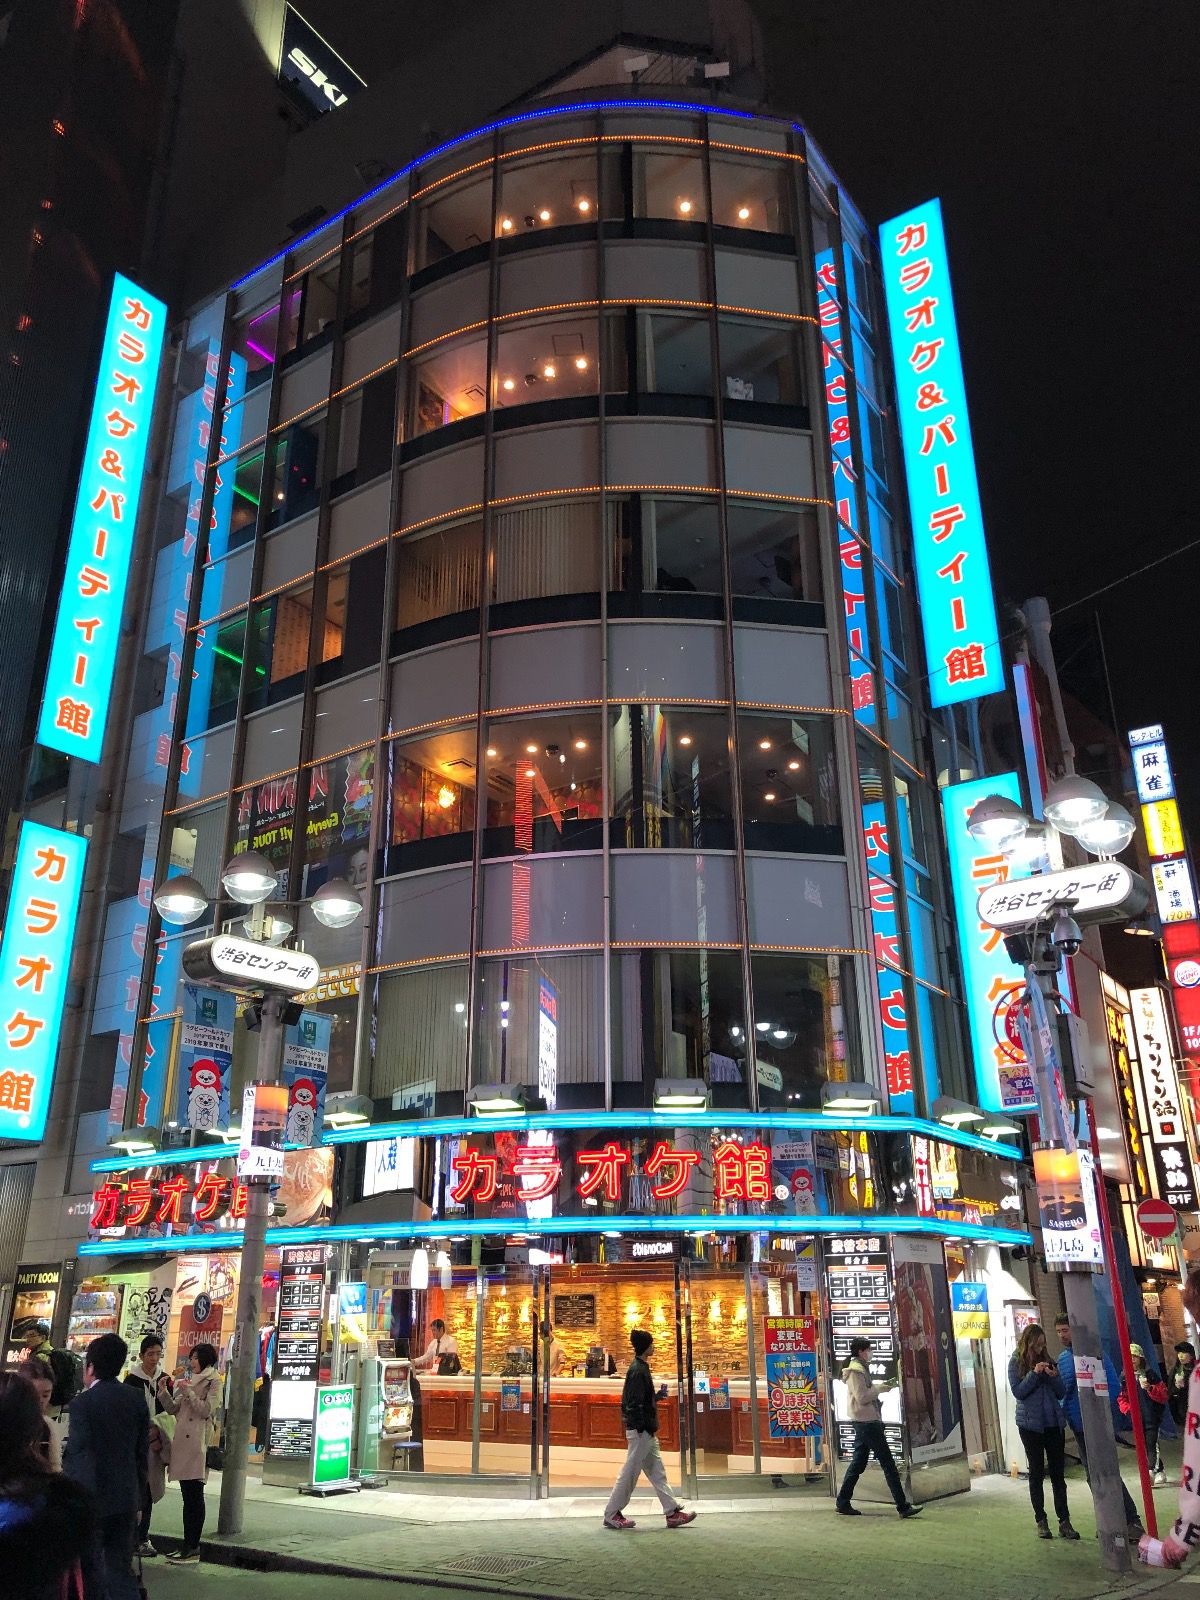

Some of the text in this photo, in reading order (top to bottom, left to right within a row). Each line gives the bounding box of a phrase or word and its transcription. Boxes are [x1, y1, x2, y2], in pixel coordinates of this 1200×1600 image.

[896, 223, 988, 686] カラオケ&パーティー館
[56, 298, 152, 738] カラオケ&パーティー館
[1142, 752, 1163, 791] 麻雀
[987, 872, 1120, 915] 渋谷センター街
[217, 946, 314, 981] 渋谷センター街
[0, 846, 68, 1113] カラオケ館
[450, 1142, 771, 1203] カラオケ館
[1167, 1194, 1192, 1205] B1F
[1048, 1216, 1084, 1229] SASEBO
[18, 1272, 59, 1285] PARTY ROOM
[766, 1318, 812, 1329] 営業時間が
[955, 1320, 989, 1330] EXCHANGE
[179, 1330, 221, 1347] EXCHANGE
[776, 1330, 804, 1341] 変更に
[770, 1342, 811, 1352] なりました。
[771, 1388, 816, 1409] 9時まで
[776, 1409, 815, 1426] 営業中
